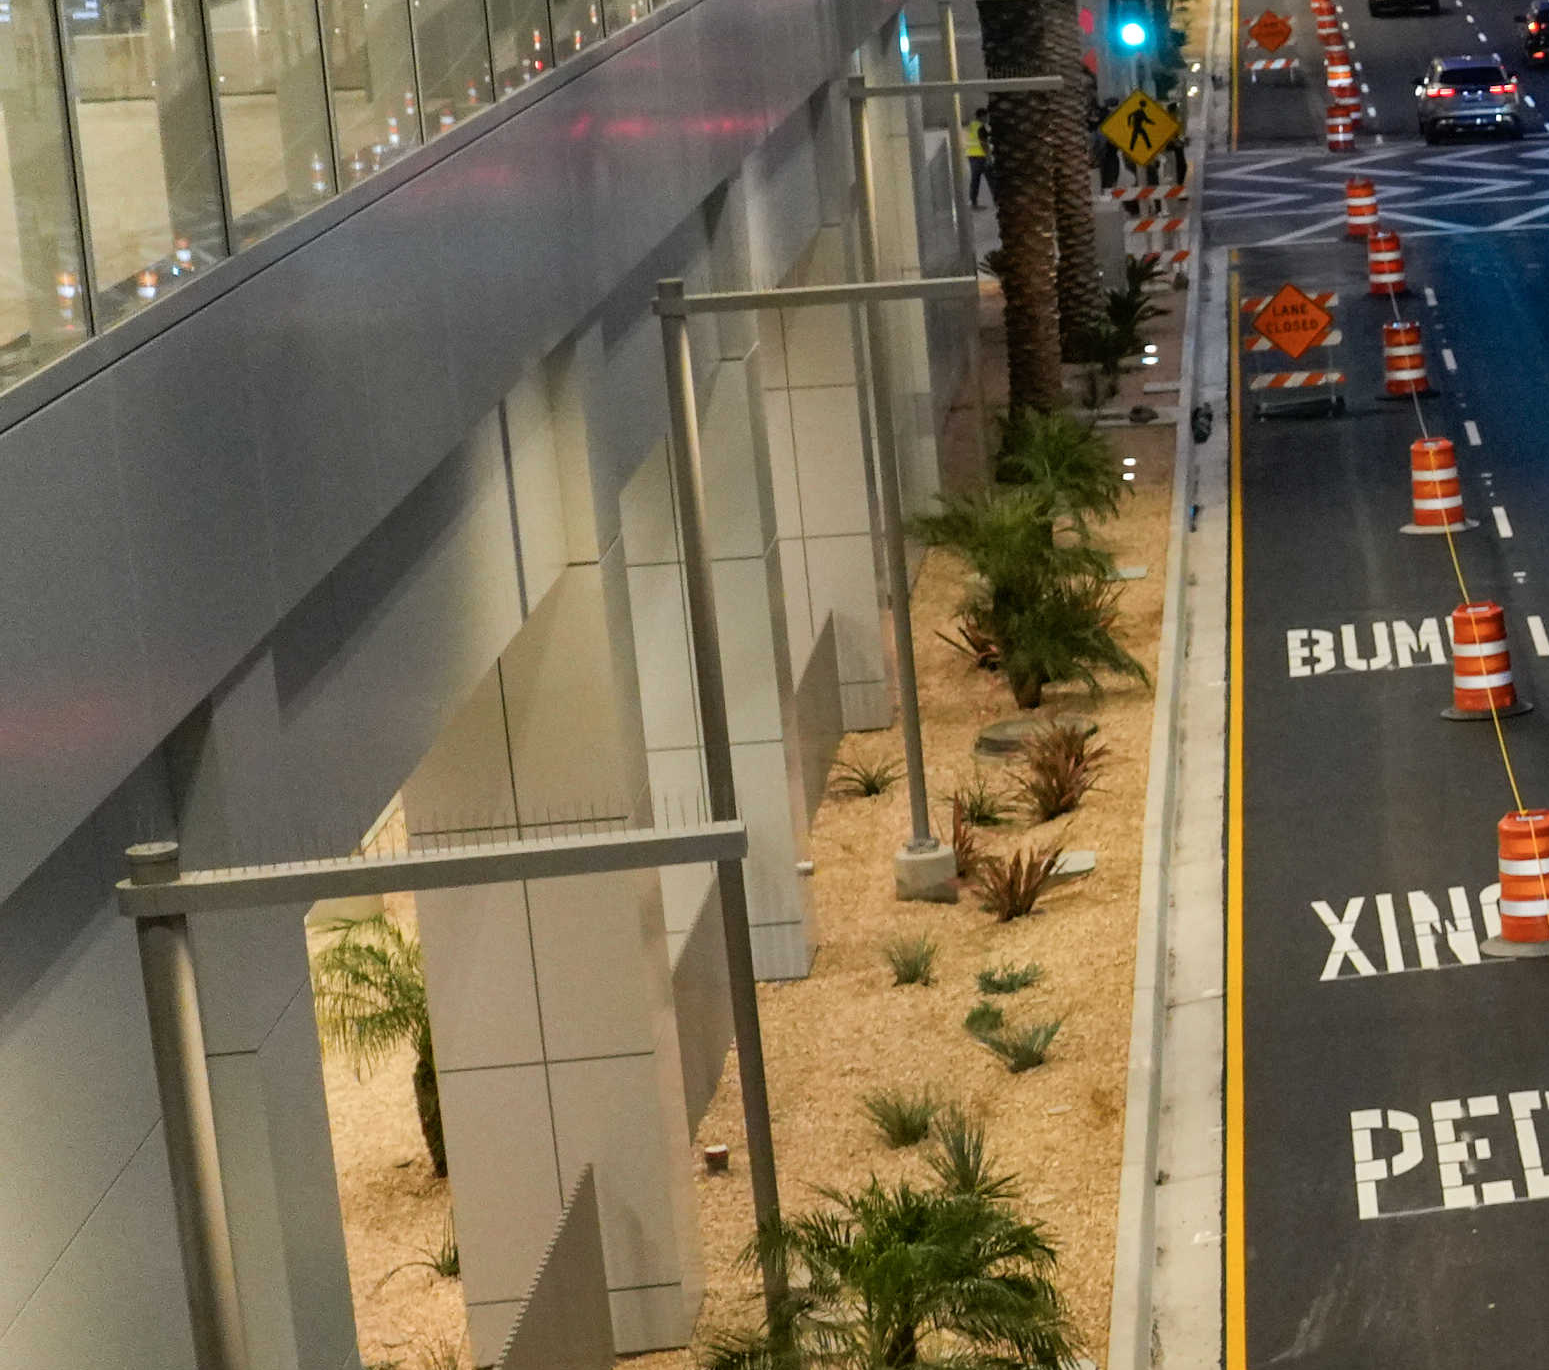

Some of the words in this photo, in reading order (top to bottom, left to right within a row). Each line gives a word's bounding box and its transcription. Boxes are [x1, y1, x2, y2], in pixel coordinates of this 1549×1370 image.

[1271, 304, 1309, 317] LANE
[1265, 318, 1319, 333] CLOSED
[1287, 616, 1455, 677] BUM
